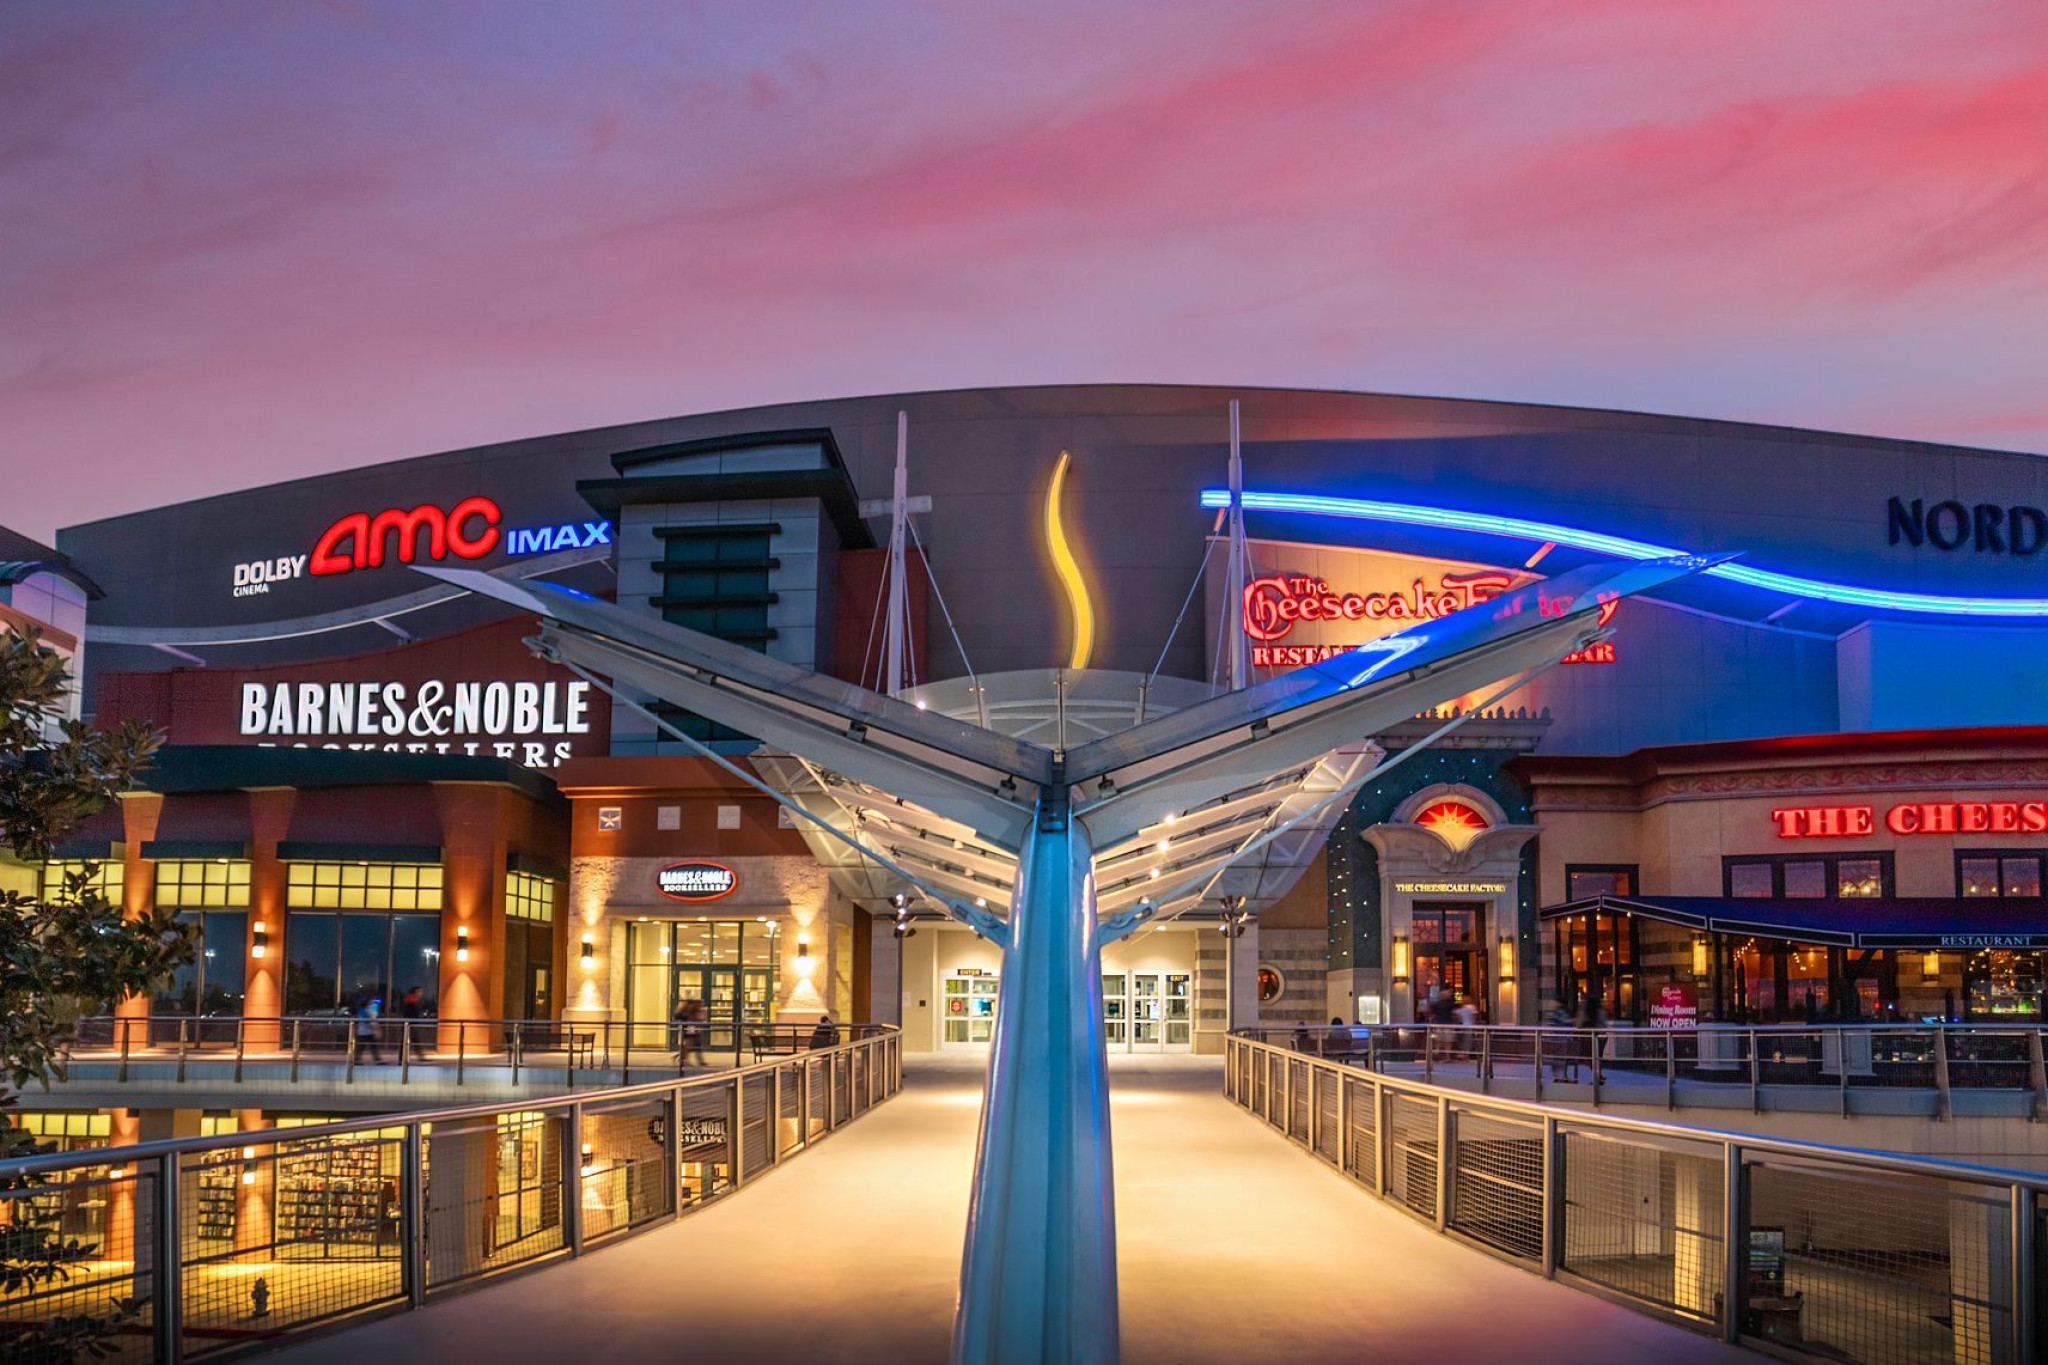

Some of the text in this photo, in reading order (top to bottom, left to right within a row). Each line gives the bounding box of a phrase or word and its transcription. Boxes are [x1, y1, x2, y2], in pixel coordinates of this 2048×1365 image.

[507, 522, 610, 554] IMAX
[1888, 496, 2048, 556] NORD
[234, 555, 306, 586] DOLBY
[233, 583, 269, 597] CINEMA
[1290, 578, 1329, 596] The
[1243, 576, 1460, 640] Cheesecake
[1774, 806, 1873, 837] THE
[1396, 883, 1414, 893] THE
[1414, 883, 1469, 893] CHEESECAKE
[1941, 936, 2032, 946] RESTAURANT
[1650, 1017, 1697, 1028] NOW OPEN
